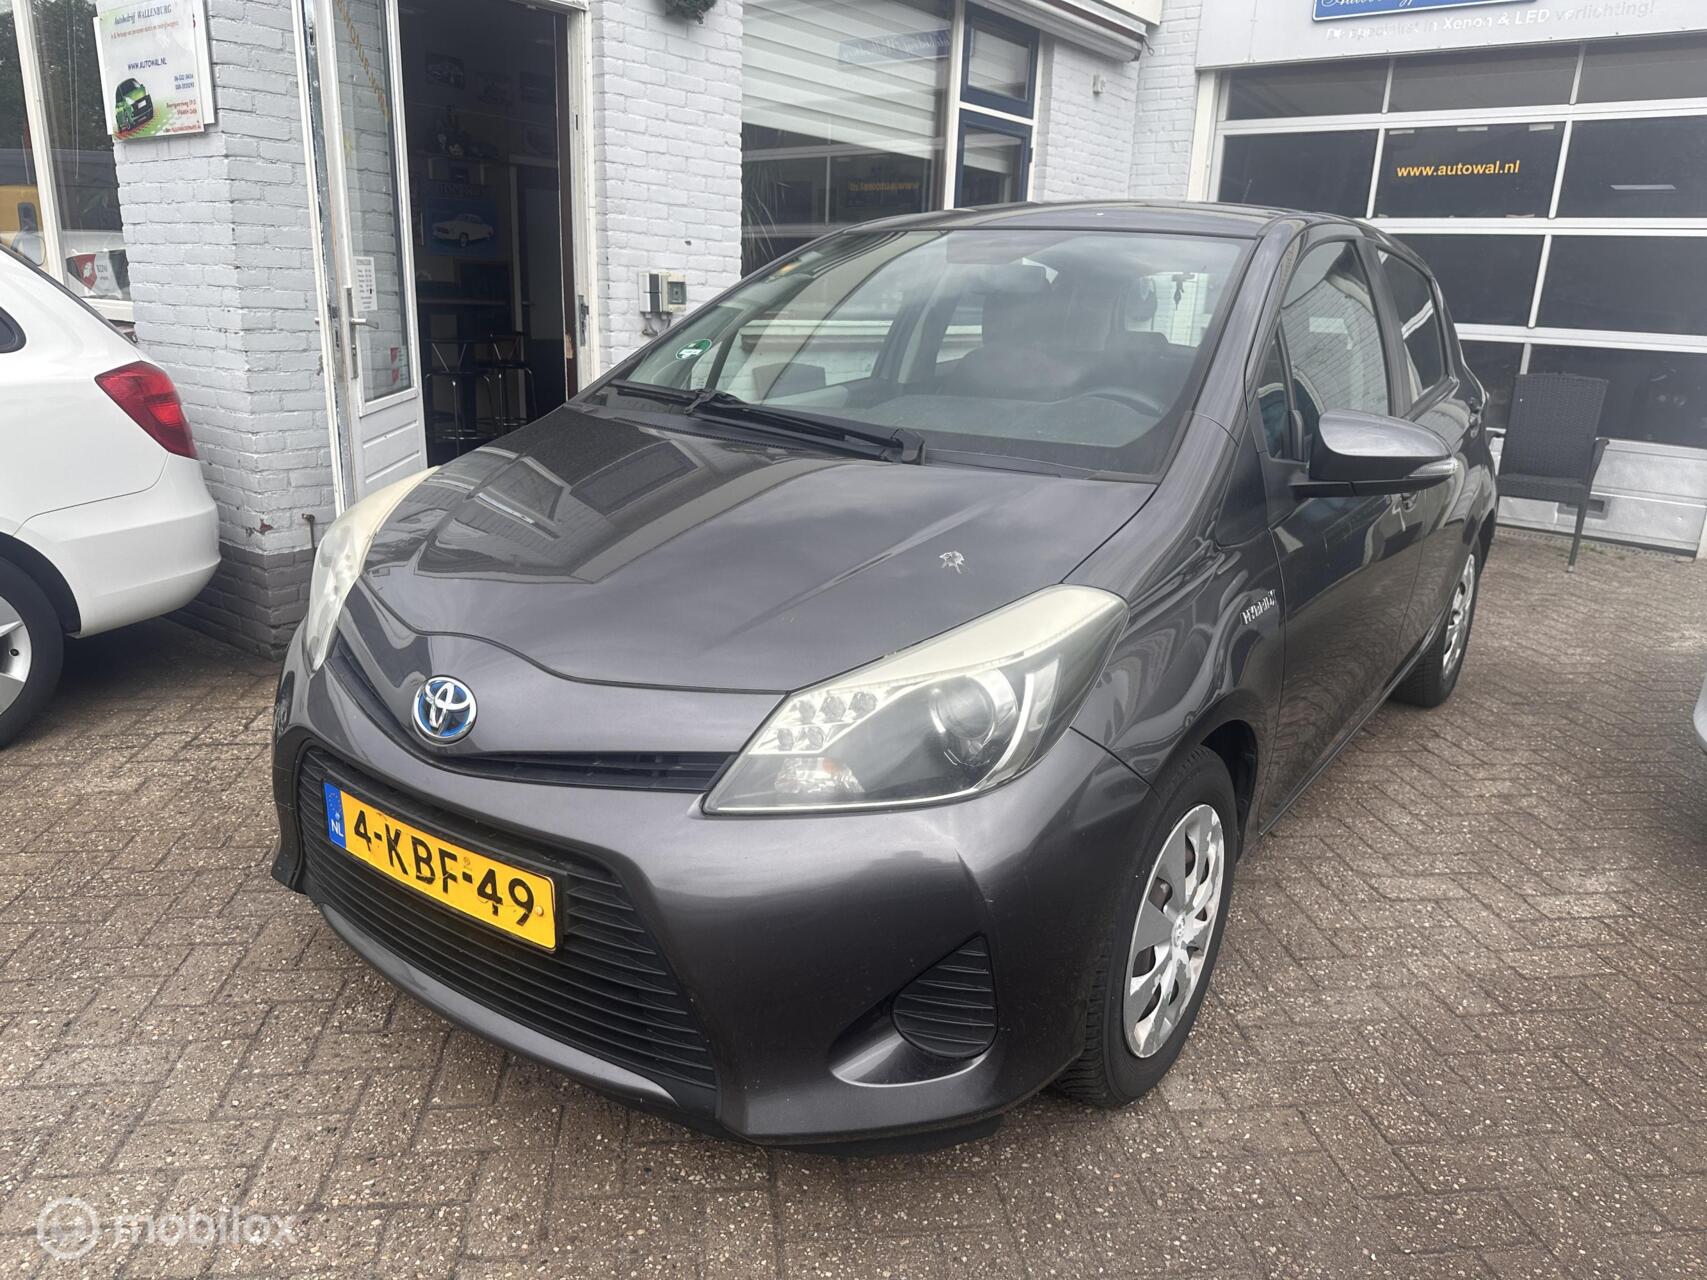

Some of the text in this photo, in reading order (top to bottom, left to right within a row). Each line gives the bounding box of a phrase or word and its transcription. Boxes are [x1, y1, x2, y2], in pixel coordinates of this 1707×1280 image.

[1496, 12, 1510, 26] &
[1515, 8, 1551, 25] LED
[1396, 160, 1520, 177] www.autowal.nl
[331, 819, 344, 837] NL
[353, 809, 535, 927] 4-KBF-49
